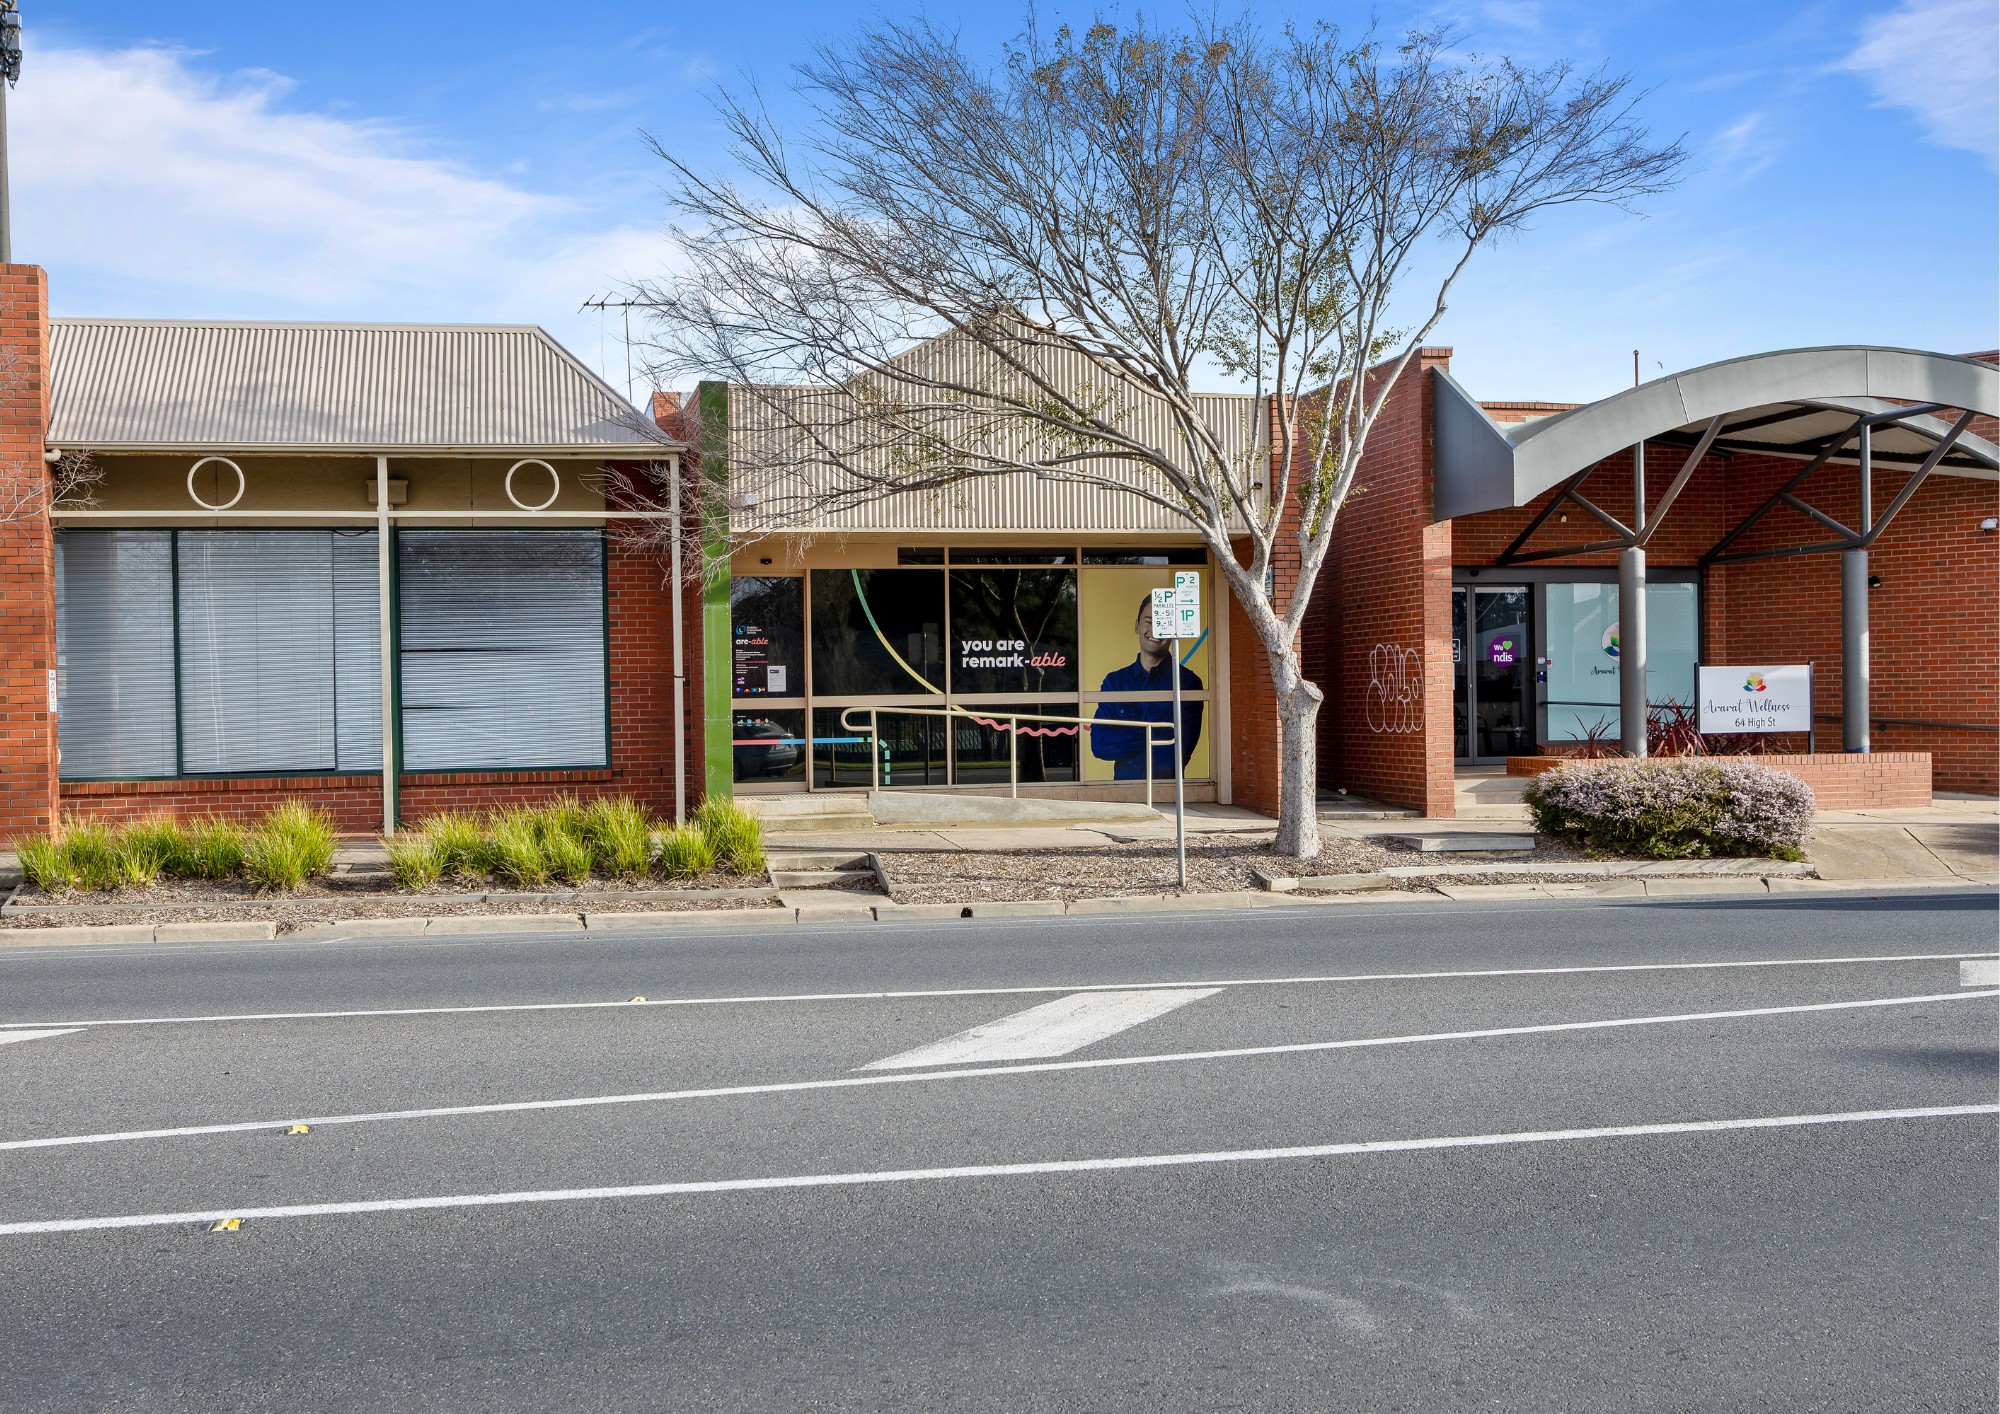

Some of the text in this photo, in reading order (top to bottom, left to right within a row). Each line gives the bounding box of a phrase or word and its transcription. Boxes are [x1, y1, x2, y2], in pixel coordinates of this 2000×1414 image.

[1176, 577, 1185, 588] P
[1180, 610, 1194, 621] 1P
[735, 637, 769, 645] are-able
[961, 639, 1025, 655] you are
[962, 651, 1066, 668] remark-able
[1493, 651, 1513, 663] ndis
[1703, 698, 1795, 714] Ararat Wellness
[1734, 717, 1776, 729] 64 High St
